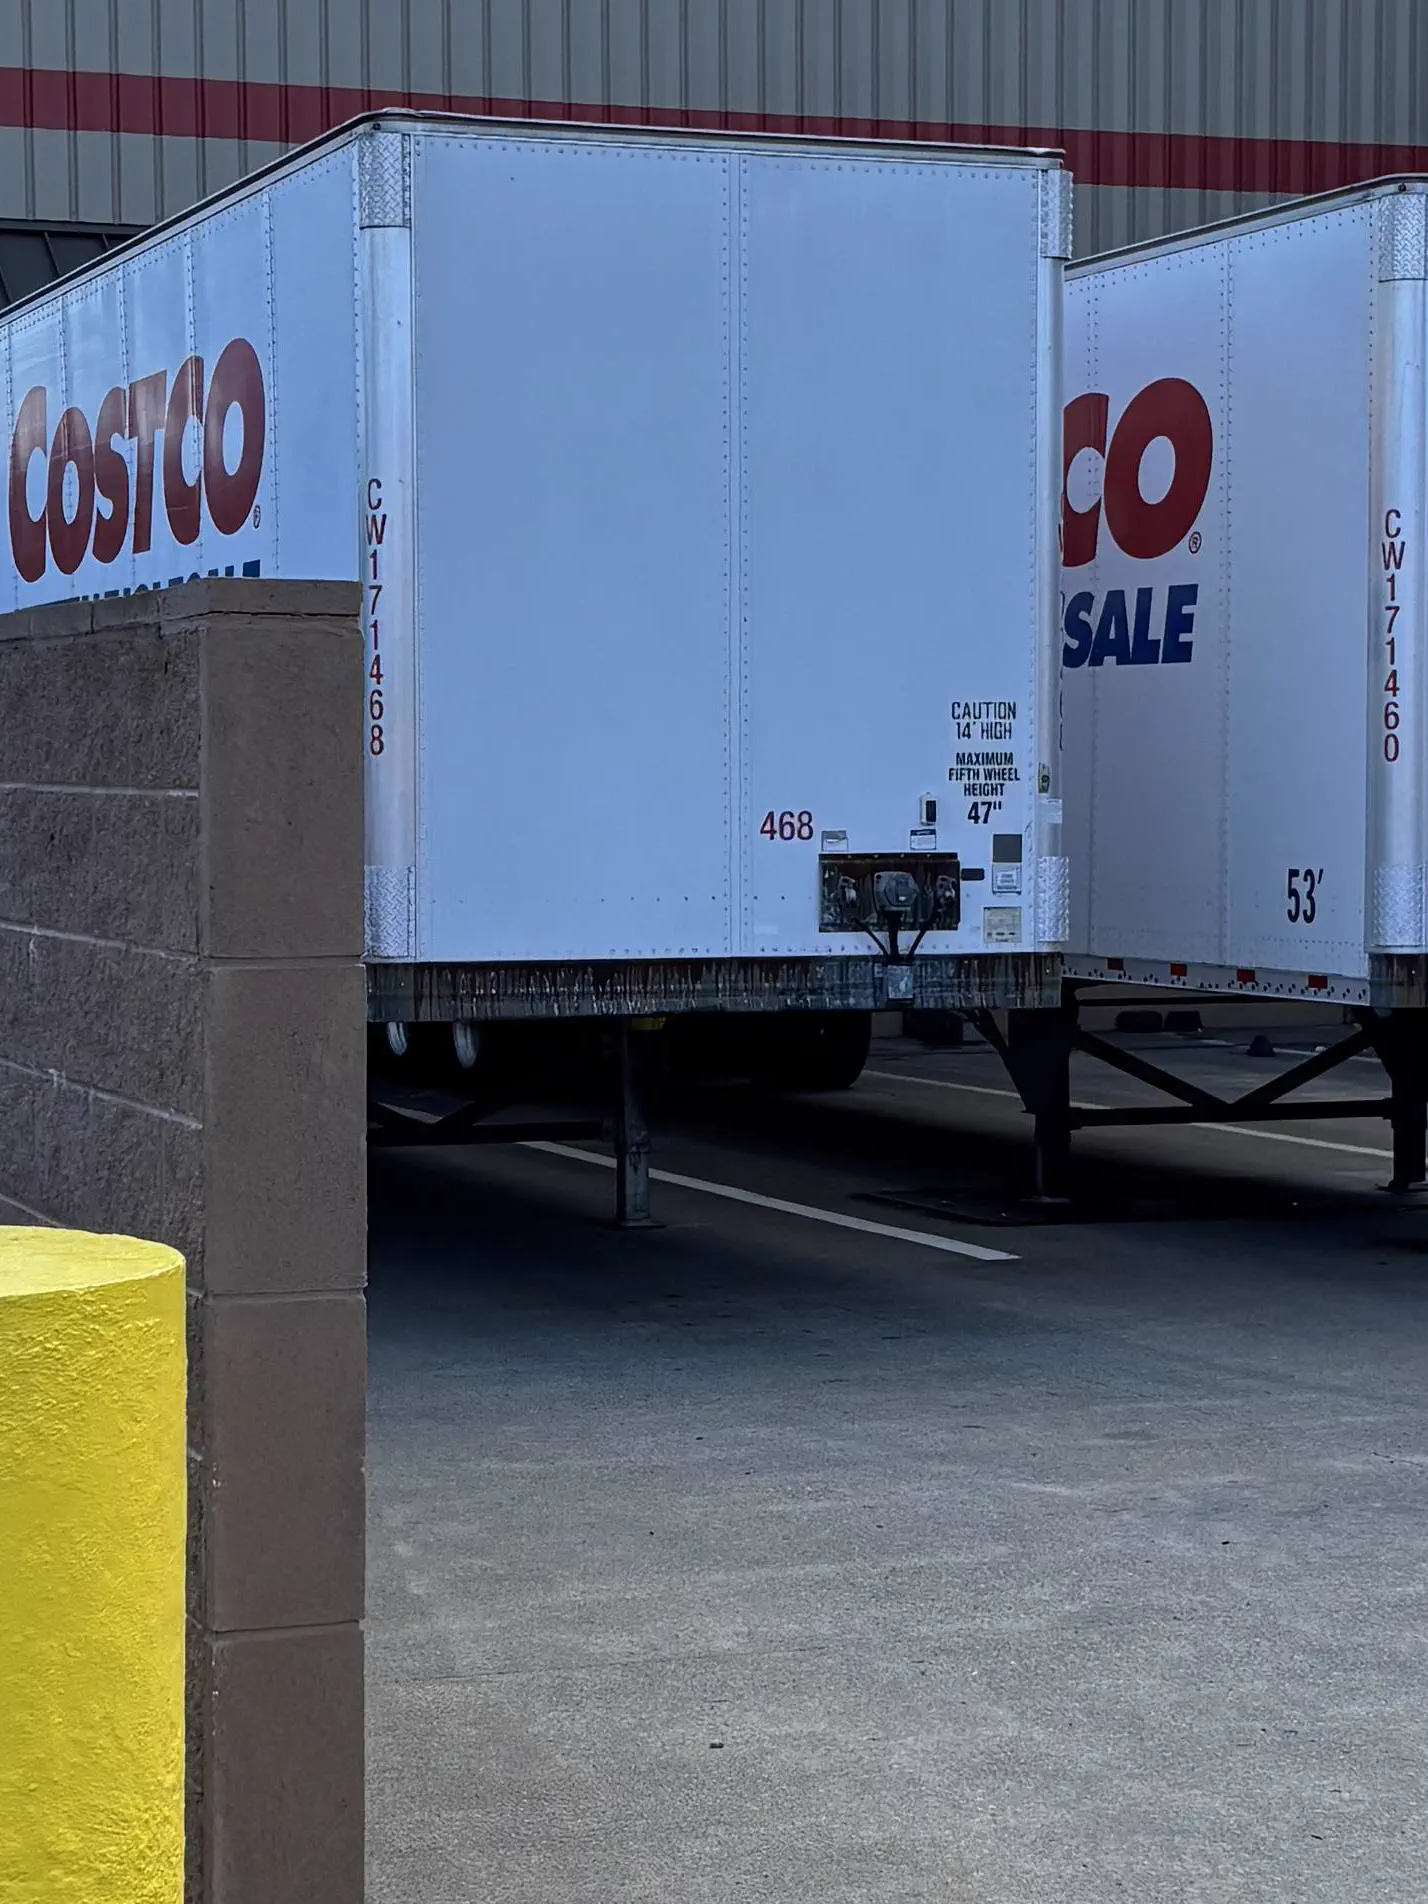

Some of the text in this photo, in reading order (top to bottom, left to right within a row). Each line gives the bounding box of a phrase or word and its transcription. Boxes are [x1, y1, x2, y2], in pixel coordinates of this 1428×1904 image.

[9, 337, 265, 583] COSTCO
[365, 478, 388, 757] CW171468
[1063, 583, 1199, 669] SALE
[1382, 508, 1407, 763] CW171460
[951, 701, 1017, 721] CAUTION
[981, 721, 1013, 741] HIGH
[956, 752, 1014, 766] MAXIMUM
[949, 768, 1021, 782] FIFTH WHEEL
[963, 783, 1005, 797] HEIGHT
[759, 810, 815, 841] 468
[967, 800, 1002, 825] 47"
[1286, 868, 1324, 924] 53'
